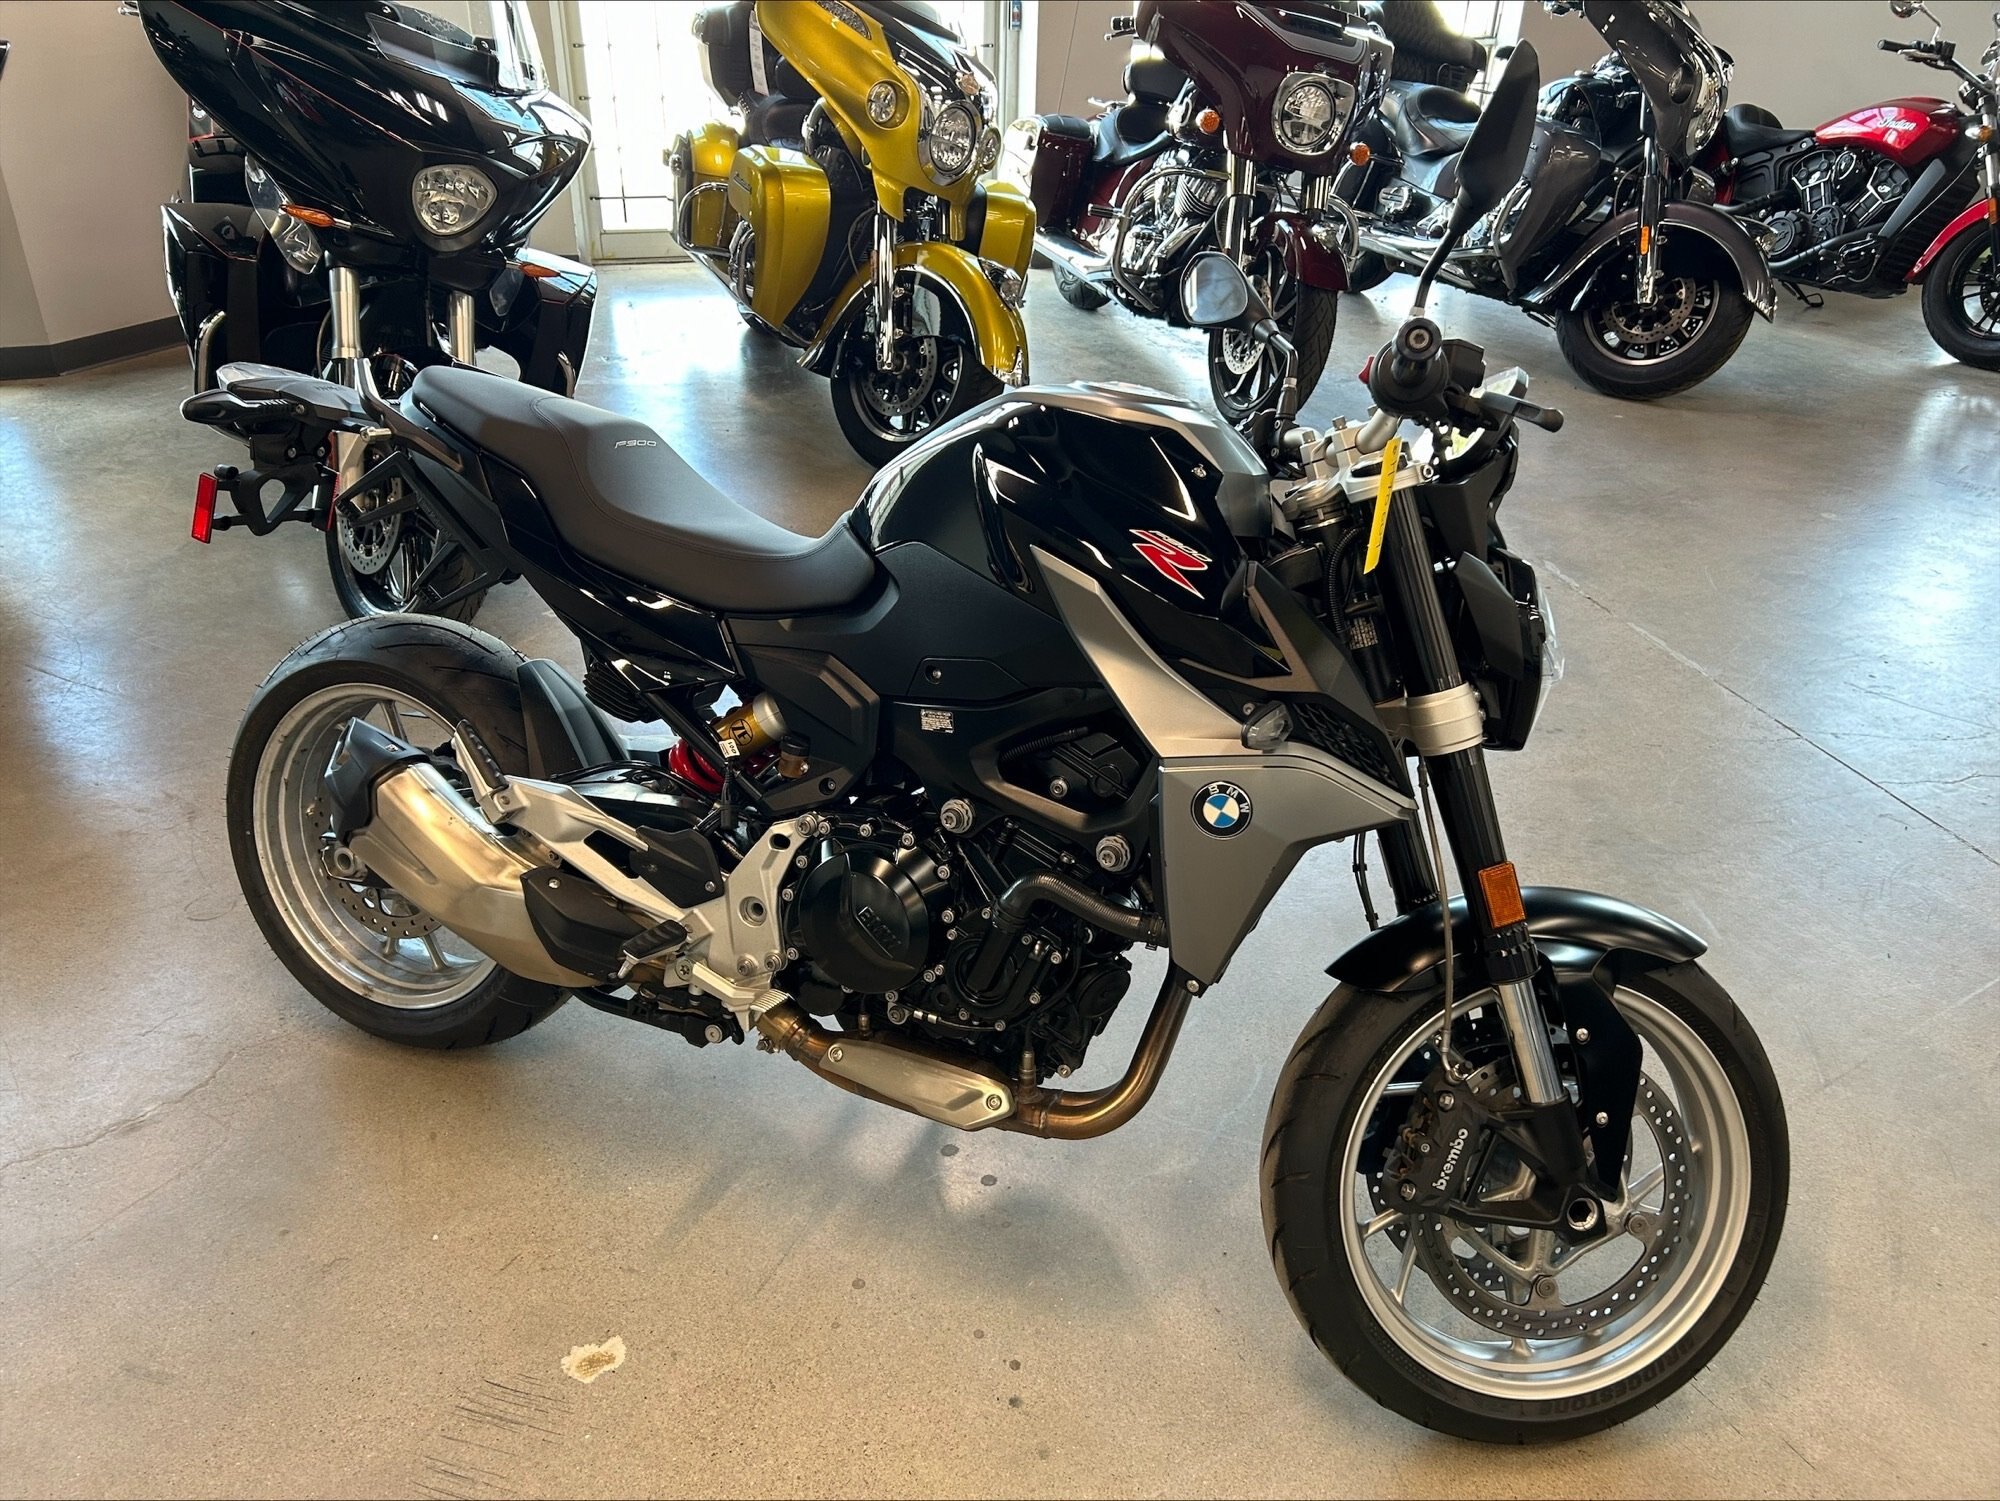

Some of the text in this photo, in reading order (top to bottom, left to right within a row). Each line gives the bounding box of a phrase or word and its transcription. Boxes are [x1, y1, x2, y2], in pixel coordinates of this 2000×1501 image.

[1878, 115, 1917, 131] Indian
[614, 439, 657, 449] F900
[730, 719, 753, 746] ZF
[1432, 1128, 1469, 1191] brembo
